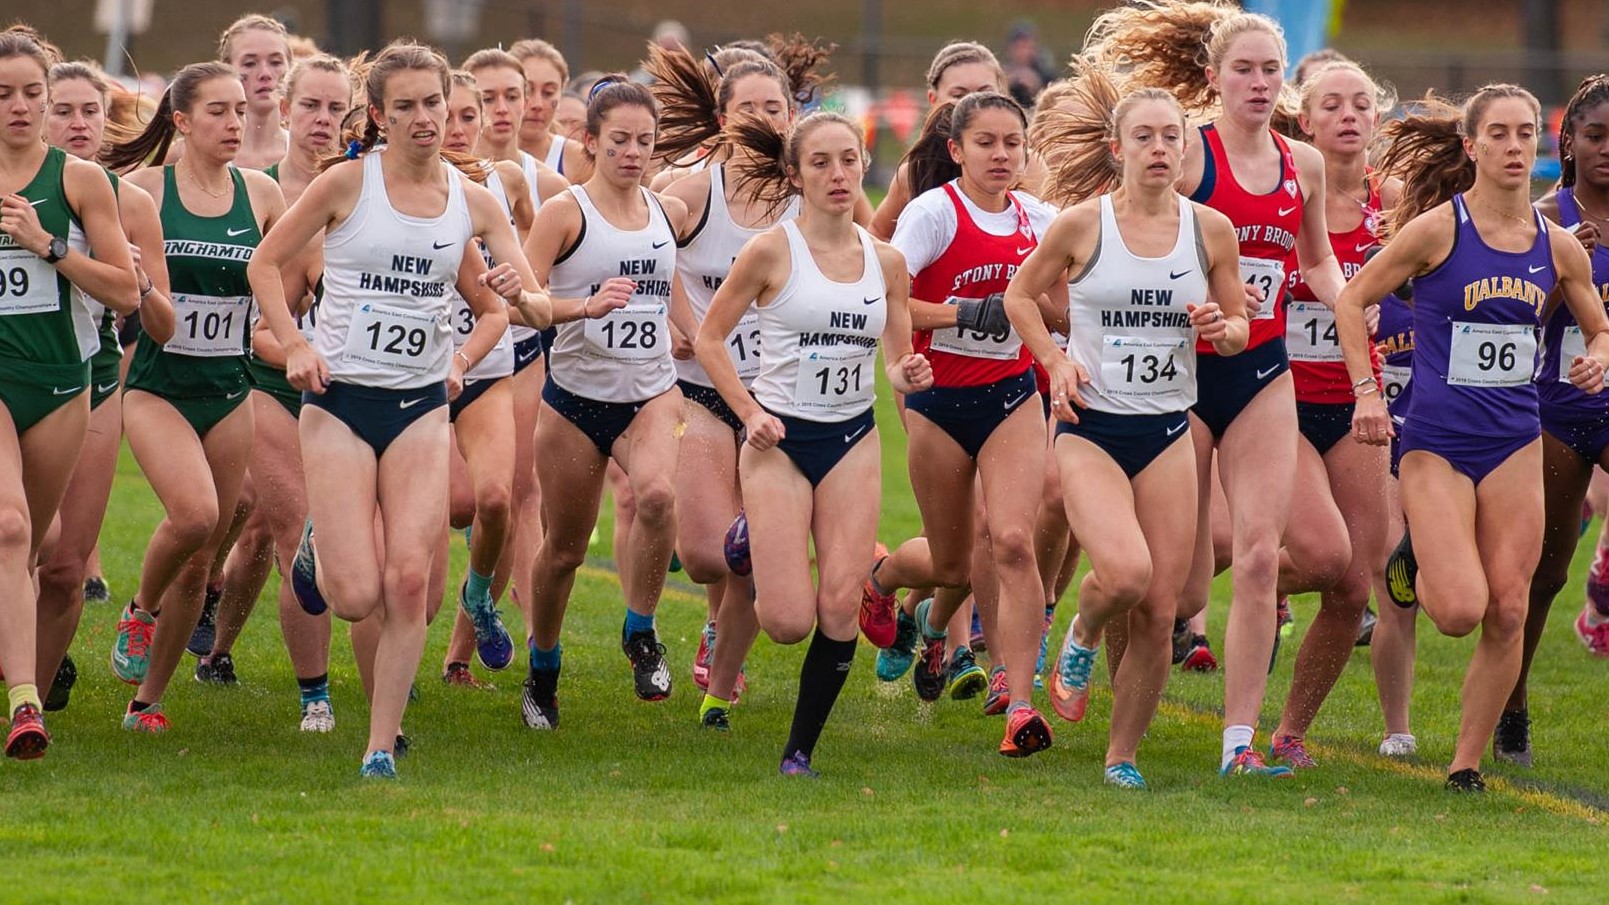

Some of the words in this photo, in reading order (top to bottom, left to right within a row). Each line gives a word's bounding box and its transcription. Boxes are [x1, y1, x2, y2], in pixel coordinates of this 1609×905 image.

[165, 241, 253, 261] INGHAMTO
[1264, 225, 1295, 251] BROO
[391, 254, 433, 275] NEW
[620, 259, 657, 276] NEW
[952, 263, 1003, 291] STONY
[1131, 288, 1173, 306] NEW
[1464, 276, 1547, 317] UALBANY
[185, 311, 233, 340] 101
[601, 320, 657, 349] 128
[830, 311, 867, 330] NEW
[366, 320, 427, 357] 129
[1121, 354, 1178, 383] 134
[1478, 341, 1517, 372] 96
[815, 363, 862, 395] 131
